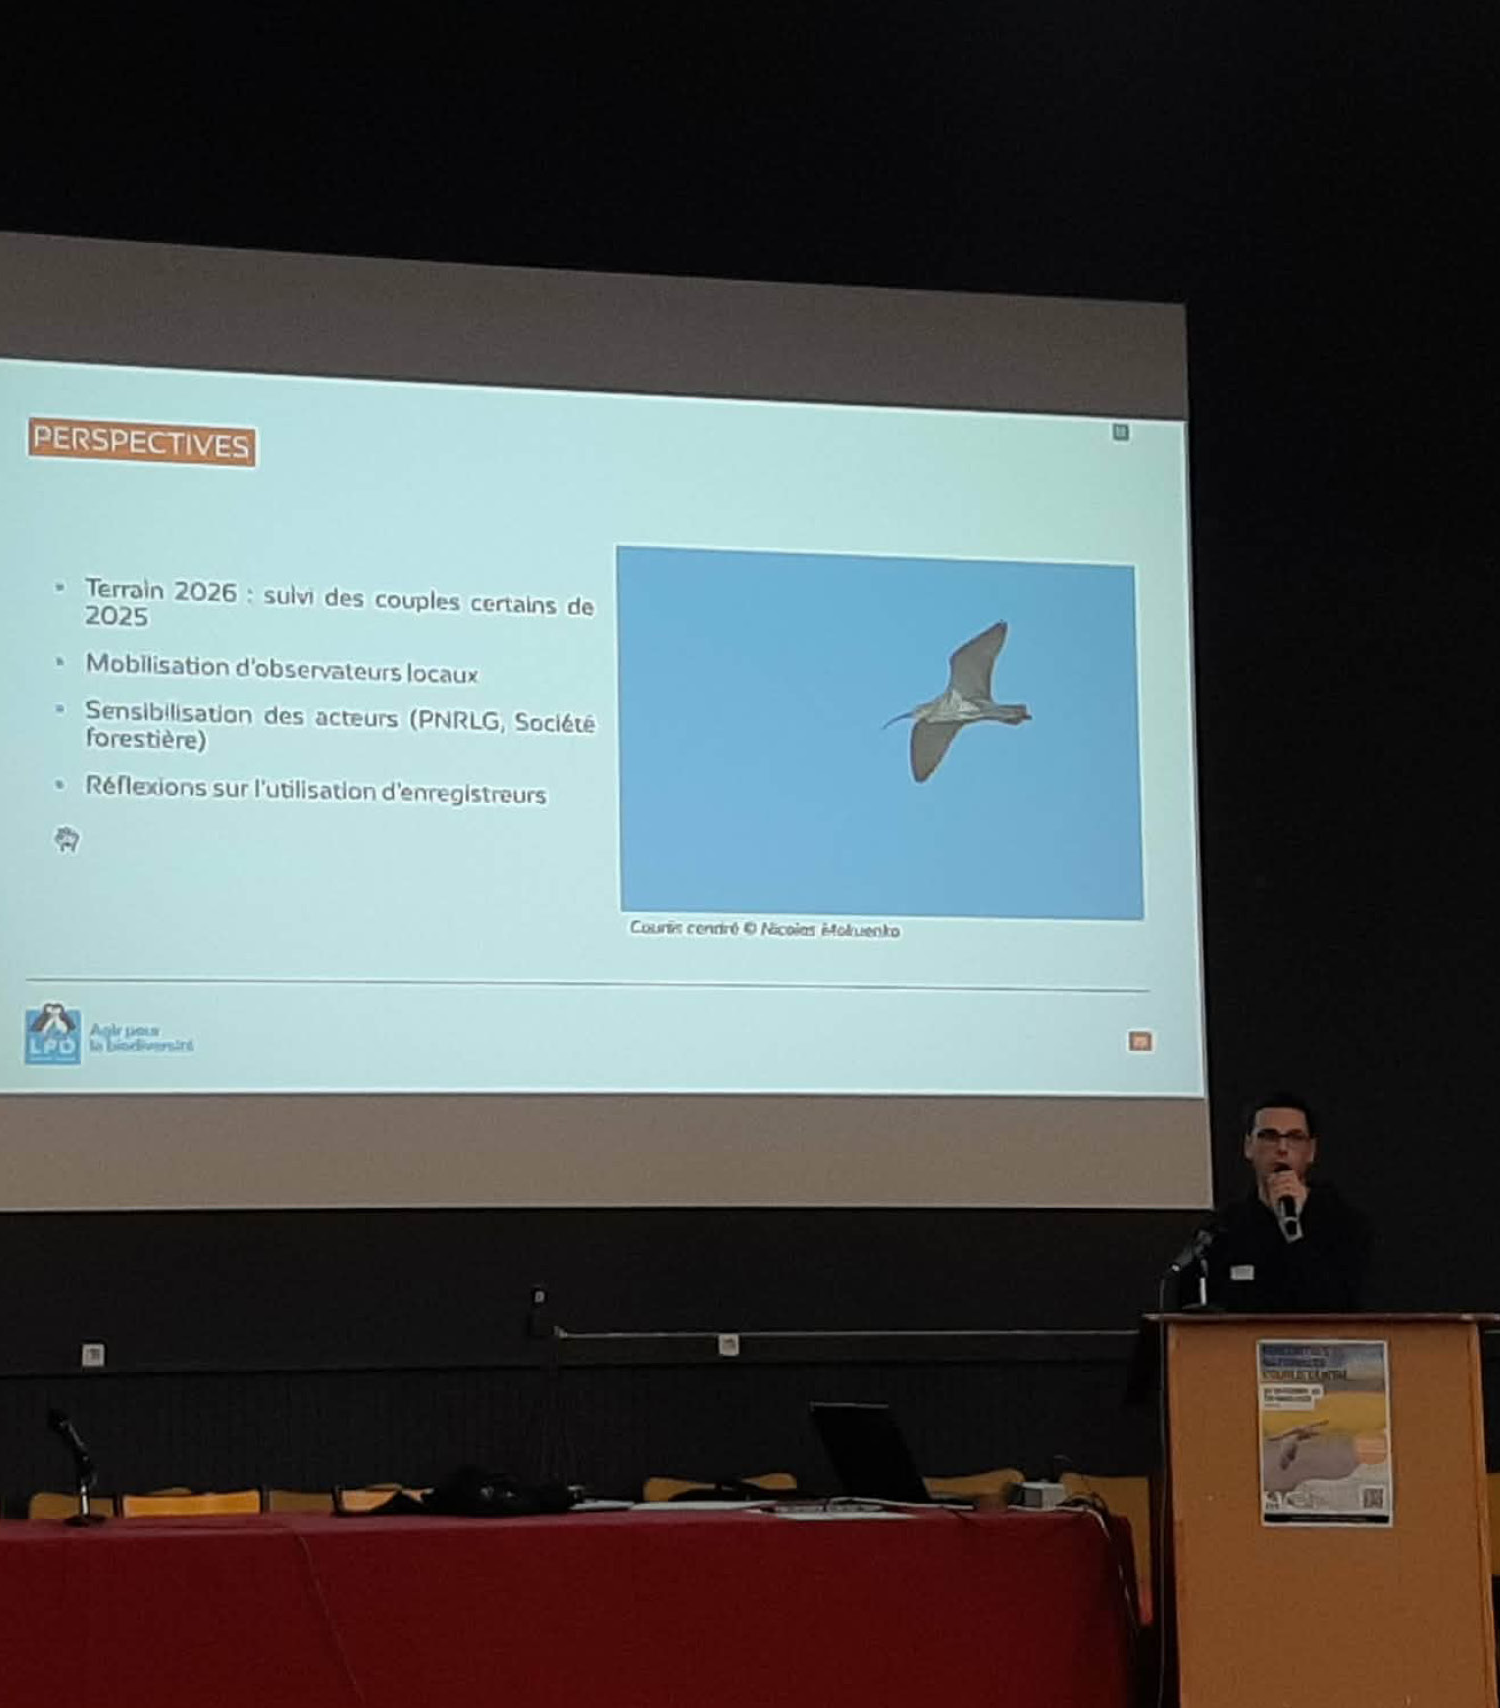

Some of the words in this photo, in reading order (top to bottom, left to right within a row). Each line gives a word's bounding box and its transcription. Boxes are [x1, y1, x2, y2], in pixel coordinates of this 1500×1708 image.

[33, 424, 251, 461] PERSPECTIVES
[85, 577, 164, 601] Terrain
[174, 580, 238, 603] 2026
[263, 583, 314, 605] suivi
[324, 587, 364, 608] des
[375, 590, 461, 614] couples
[470, 593, 558, 615] certains
[567, 596, 595, 617] de
[85, 605, 148, 627] 2025
[86, 652, 230, 676] Mobilisation
[235, 657, 402, 683] d'observateurs
[407, 662, 479, 684] locaux
[86, 699, 253, 724] Sensibilisation
[263, 705, 304, 726] des
[315, 709, 399, 729] acteurs
[410, 708, 505, 735] (PNRLG,
[515, 711, 596, 734] Société
[86, 727, 208, 754] forestière)
[86, 774, 207, 798] Réflexions
[213, 782, 249, 798] sur
[254, 778, 377, 802] l'utilisation
[381, 780, 548, 808] d'enregistreurs
